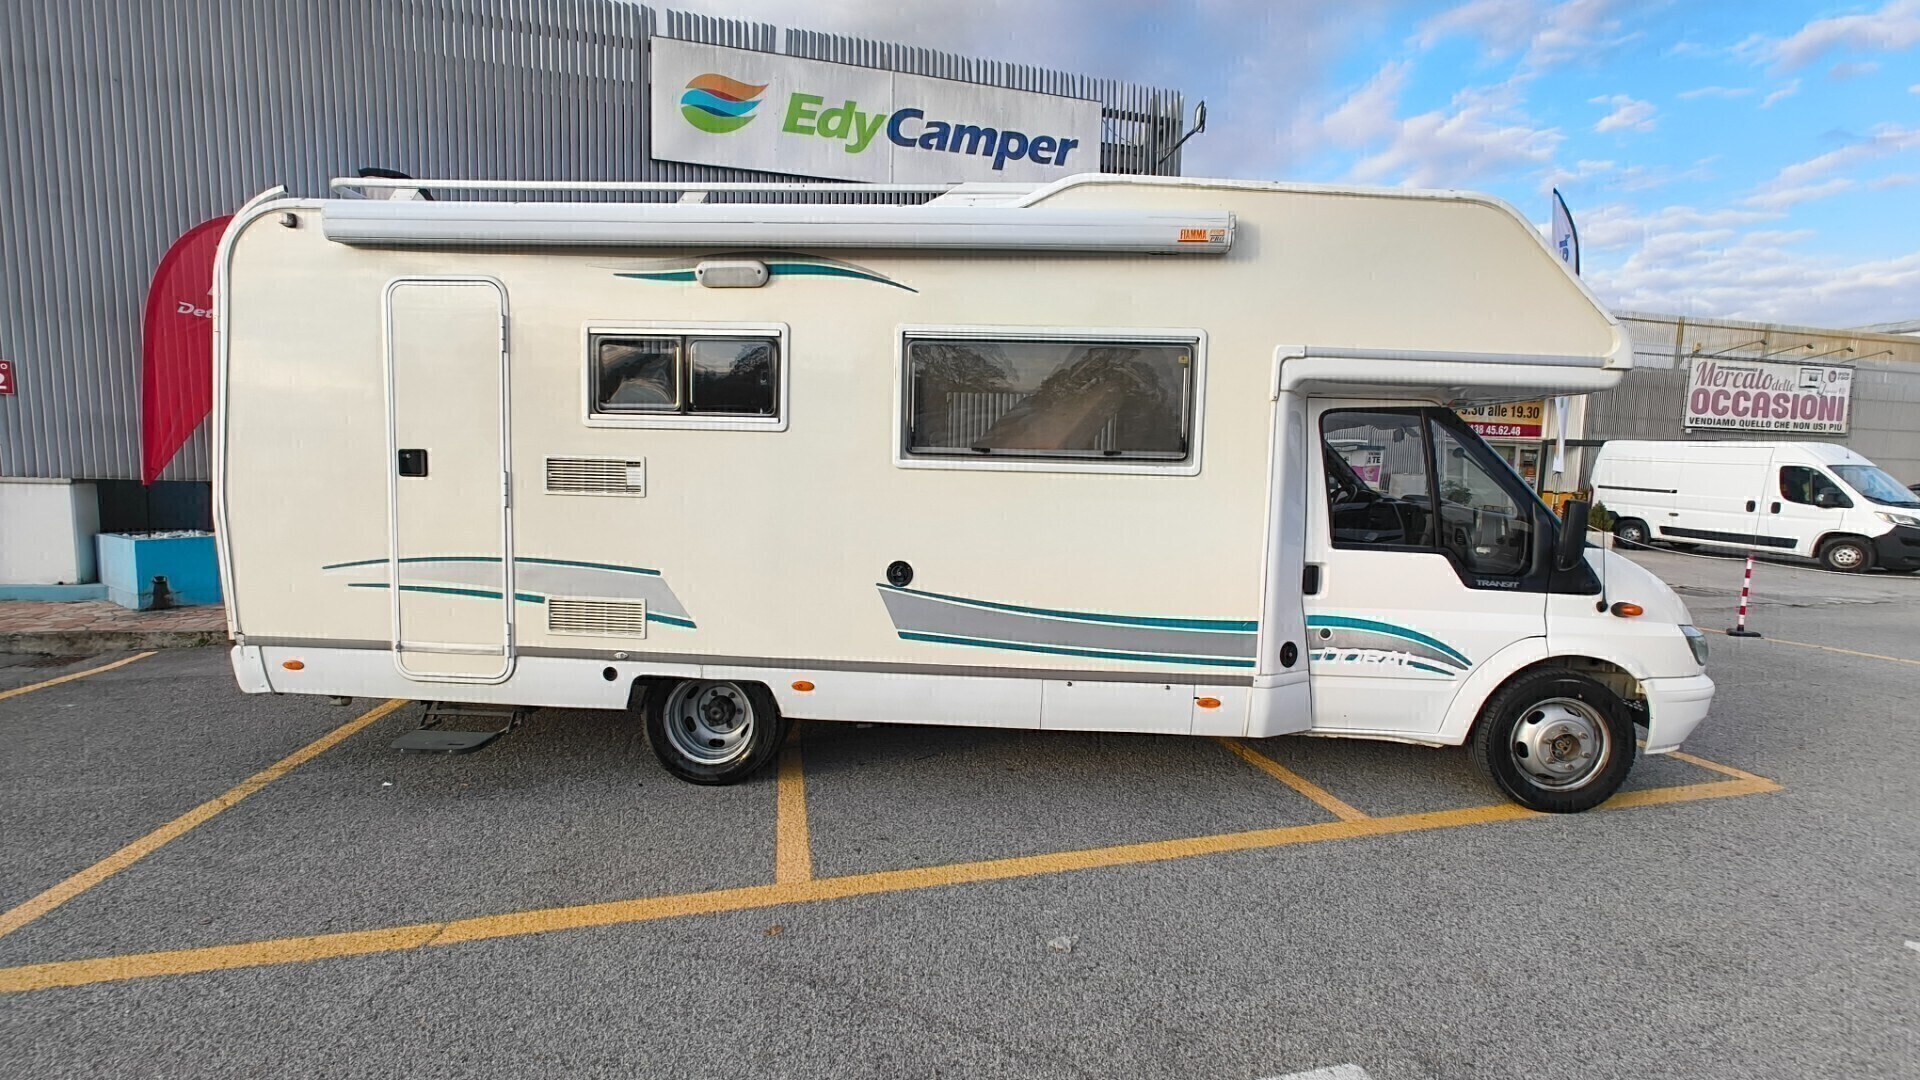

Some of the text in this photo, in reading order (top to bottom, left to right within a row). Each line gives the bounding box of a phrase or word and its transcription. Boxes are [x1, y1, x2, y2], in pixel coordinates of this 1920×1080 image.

[782, 92, 1079, 171] EdyCamper
[1180, 229, 1206, 239] FIAMMA
[1694, 361, 1773, 389] Mercato
[1771, 378, 1796, 392] delle
[1488, 405, 1507, 417] alle
[1511, 406, 1540, 419] 19.30
[1690, 388, 1845, 422] OCCASIONI
[1486, 425, 1521, 436] 45.62.48
[1689, 417, 1736, 428] VENDIAMO
[1739, 419, 1772, 429] QUELLO
[1774, 421, 1790, 430] CHE
[1793, 422, 1811, 431] NON
[1813, 423, 1826, 431] USI
[1476, 579, 1520, 589] TRANSIT
